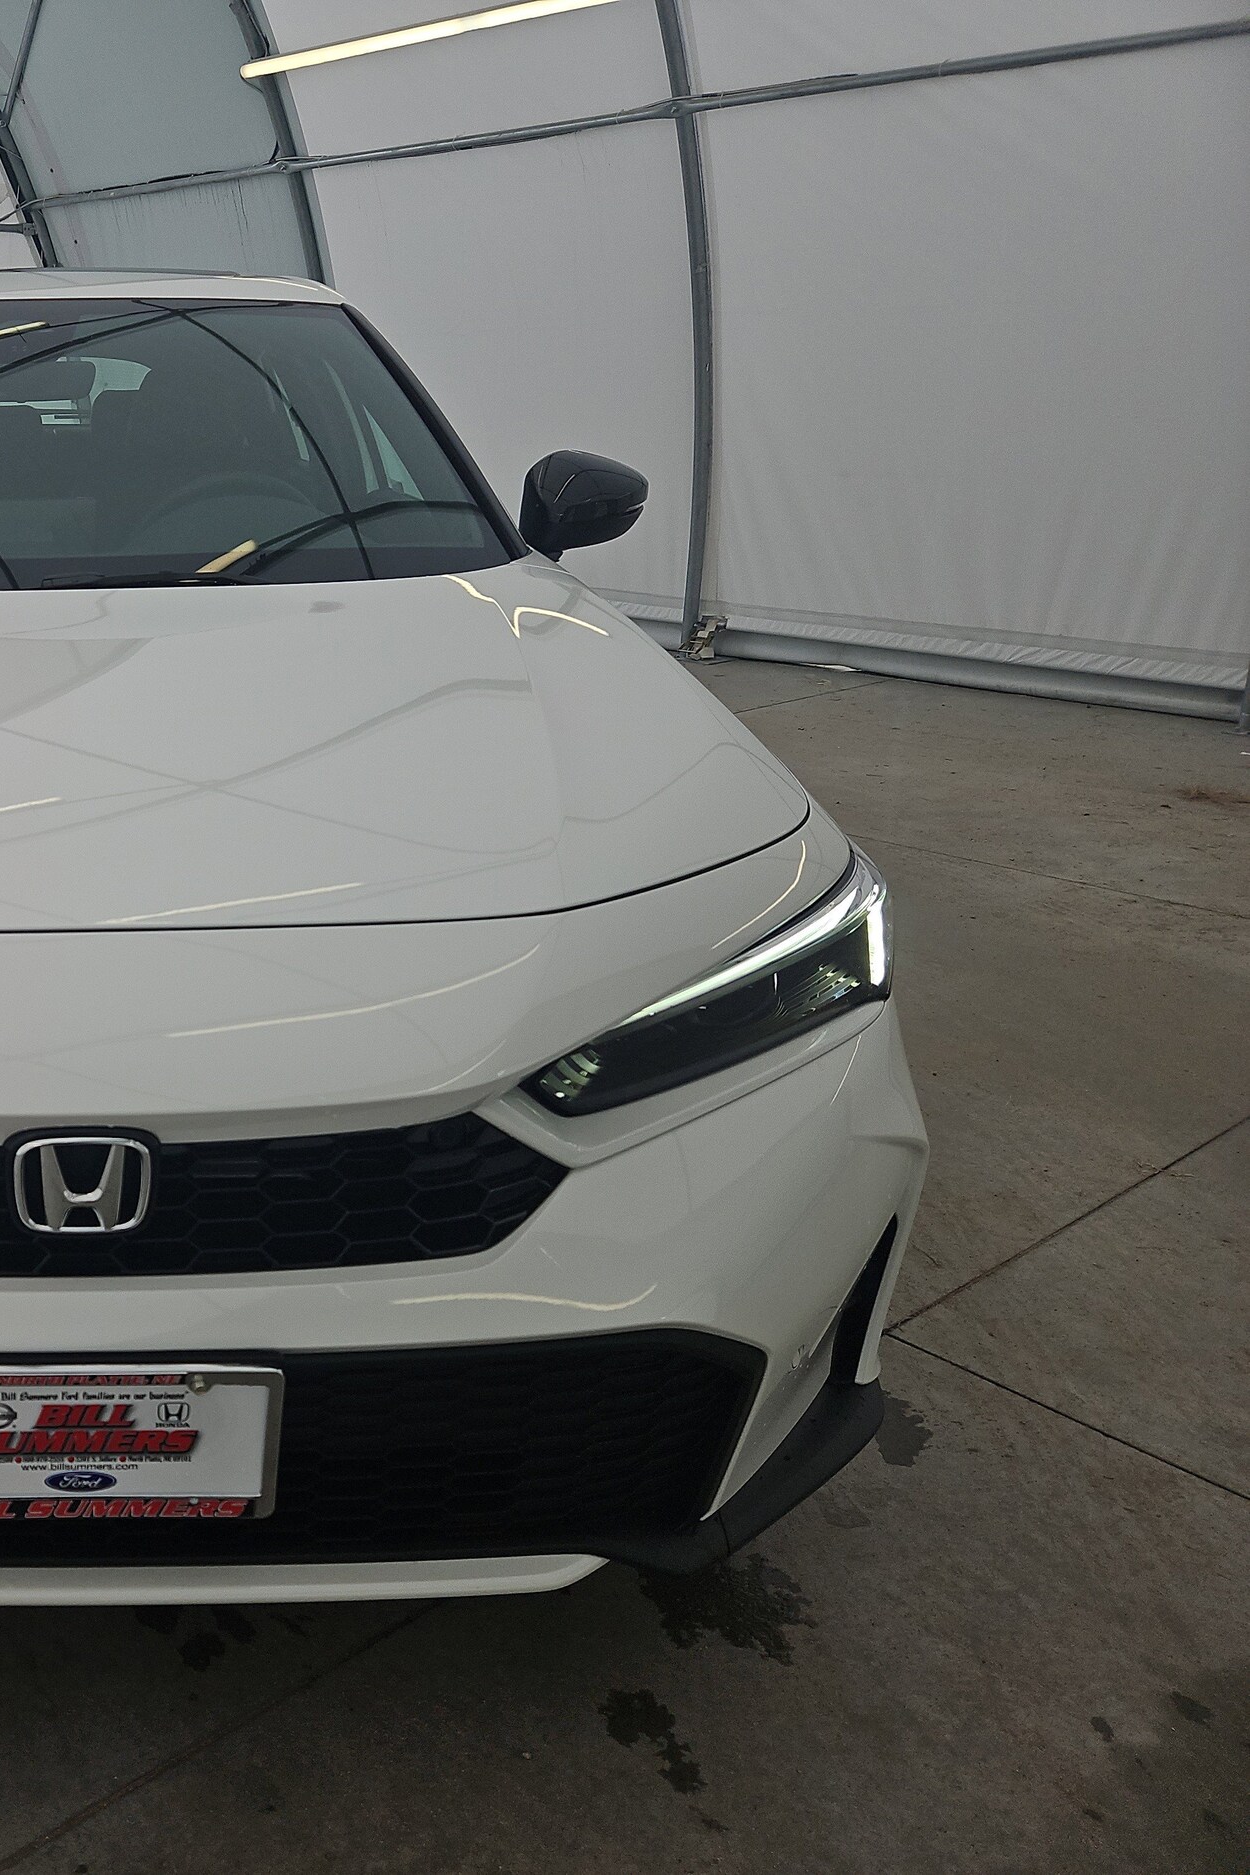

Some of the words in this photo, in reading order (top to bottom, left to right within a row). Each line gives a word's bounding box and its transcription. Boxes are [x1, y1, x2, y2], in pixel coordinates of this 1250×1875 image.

[0, 1391, 17, 1401] Bill
[61, 1391, 80, 1401] Ford
[33, 1404, 136, 1429] BILL
[21, 1463, 138, 1472] www.billsummers.com
[58, 1474, 103, 1489] Ford
[24, 1498, 249, 1519] SUMMERS
